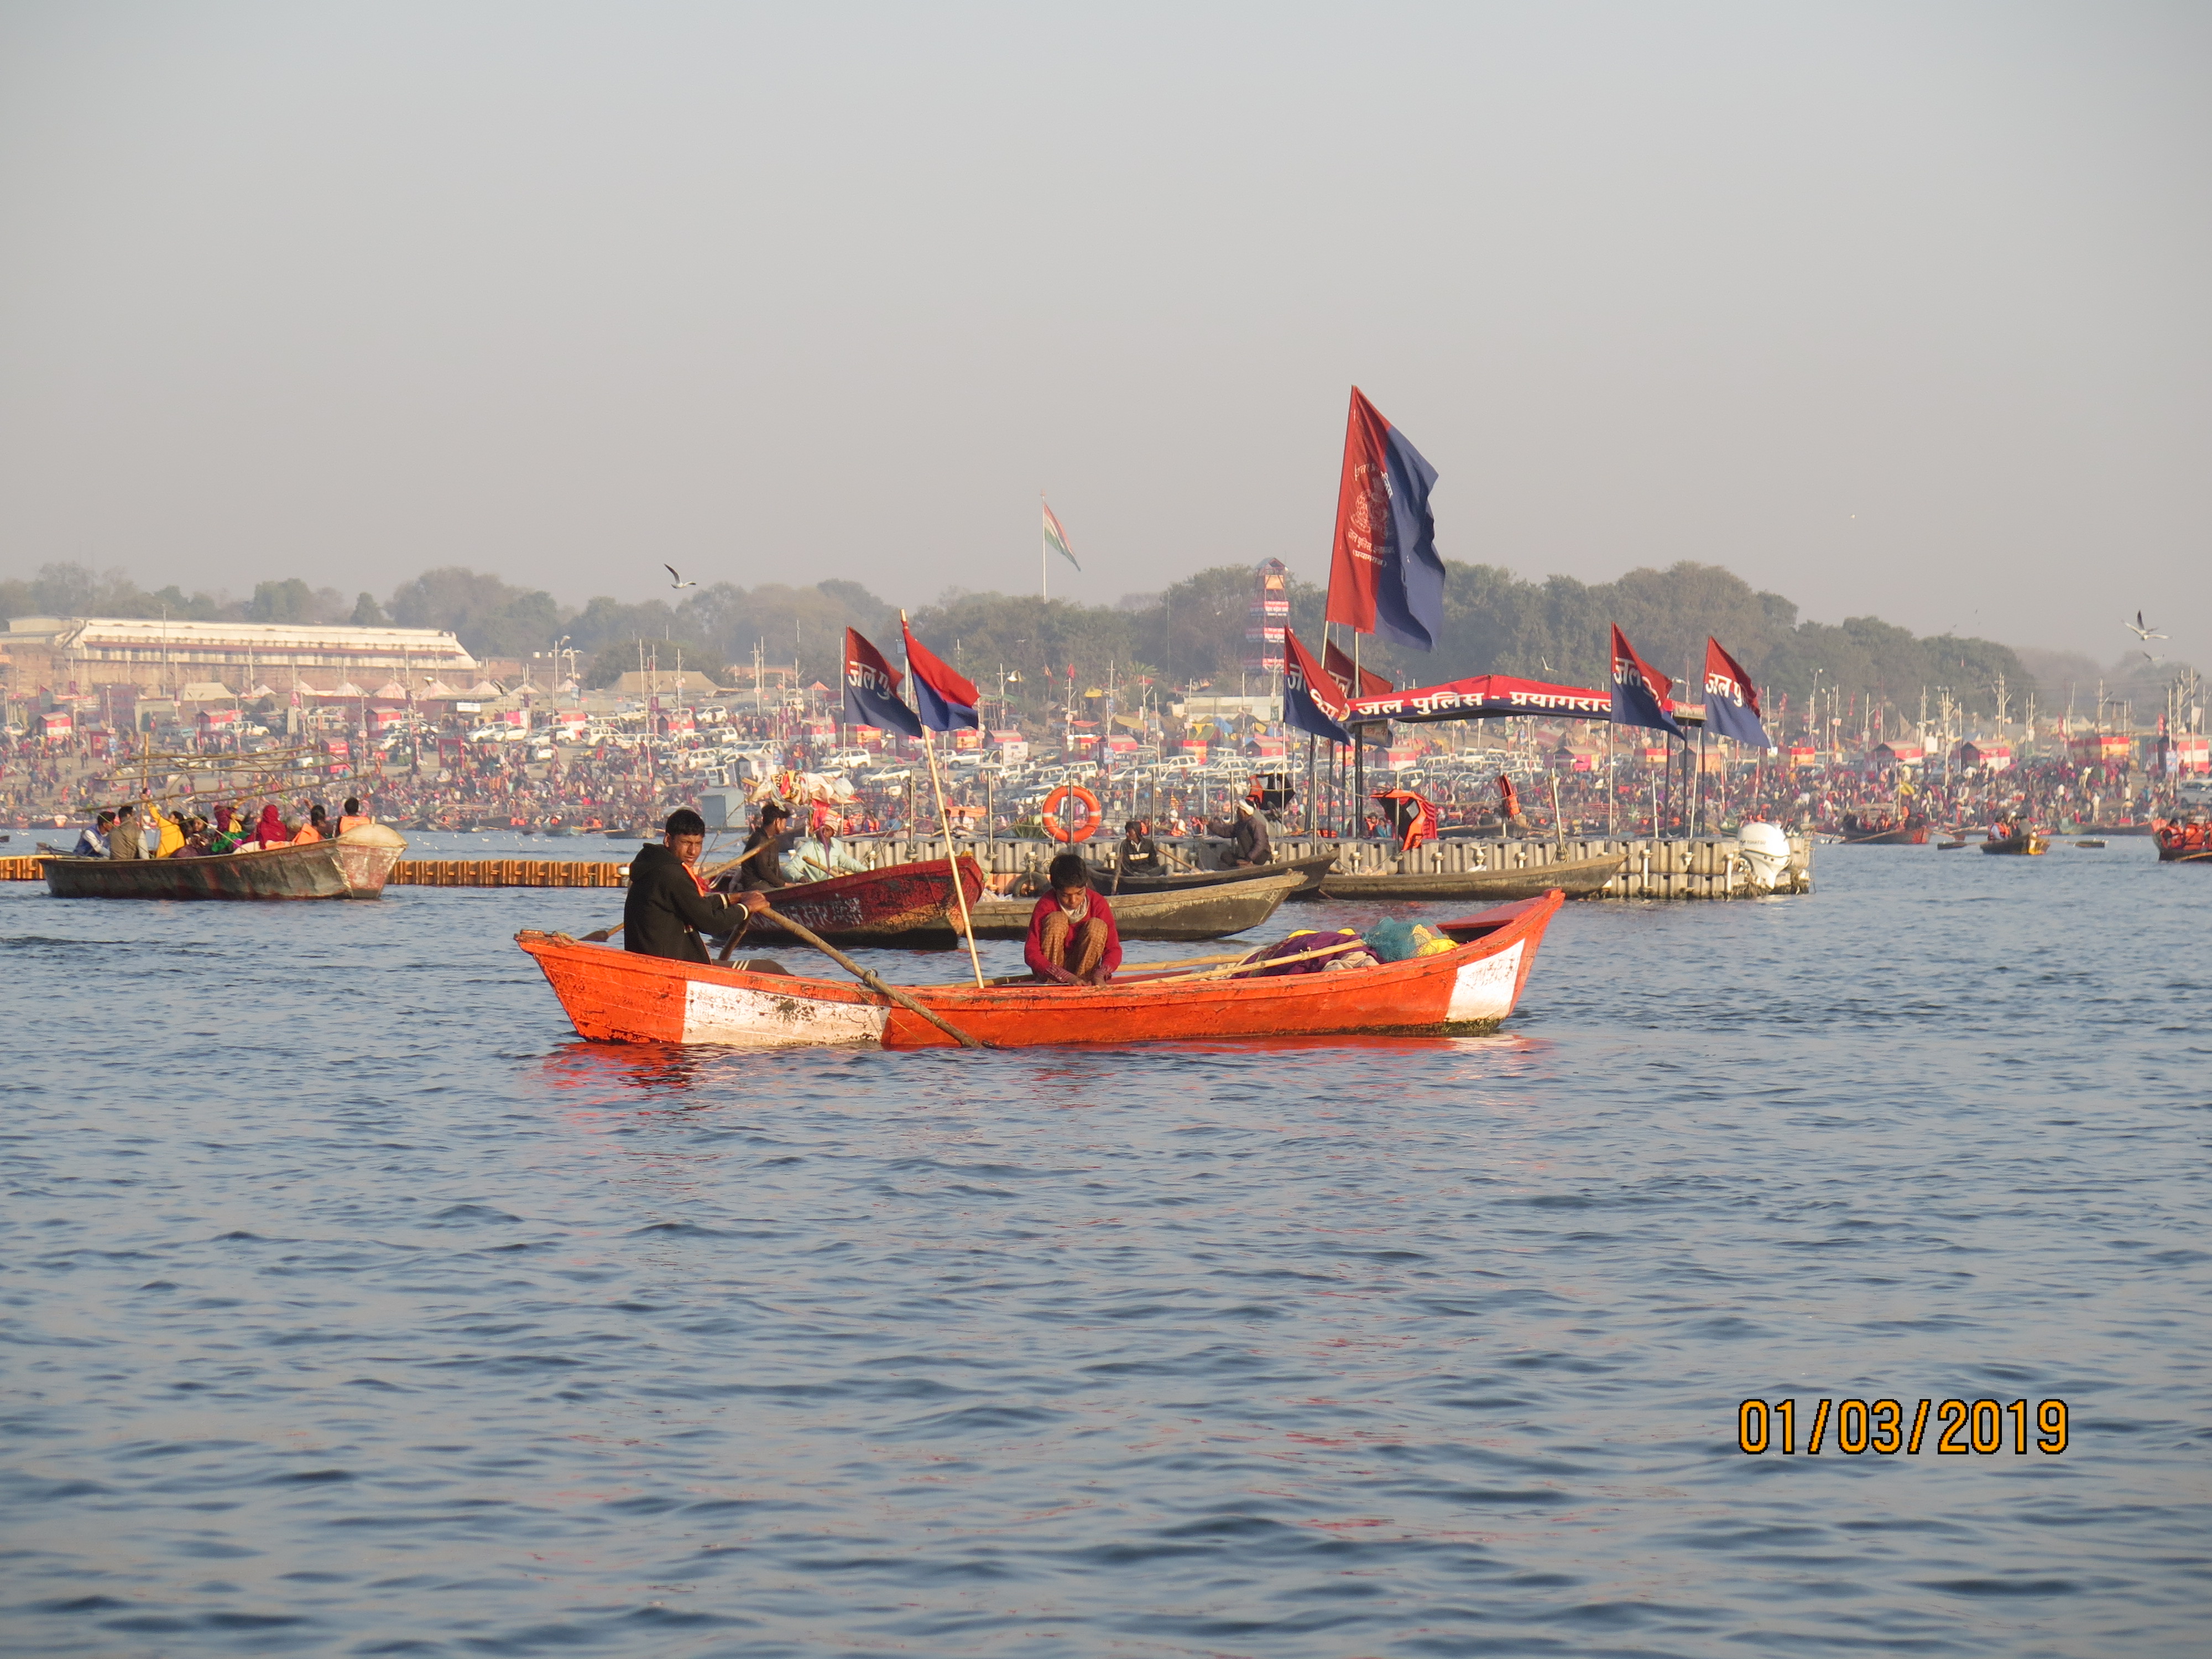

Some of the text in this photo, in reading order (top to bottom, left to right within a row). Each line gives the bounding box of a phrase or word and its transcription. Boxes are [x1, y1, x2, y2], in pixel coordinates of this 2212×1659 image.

[848, 660, 877, 691] जल
[1705, 672, 1731, 698] जल
[1355, 699, 1404, 715] जल
[1410, 691, 1485, 716] पुलिस
